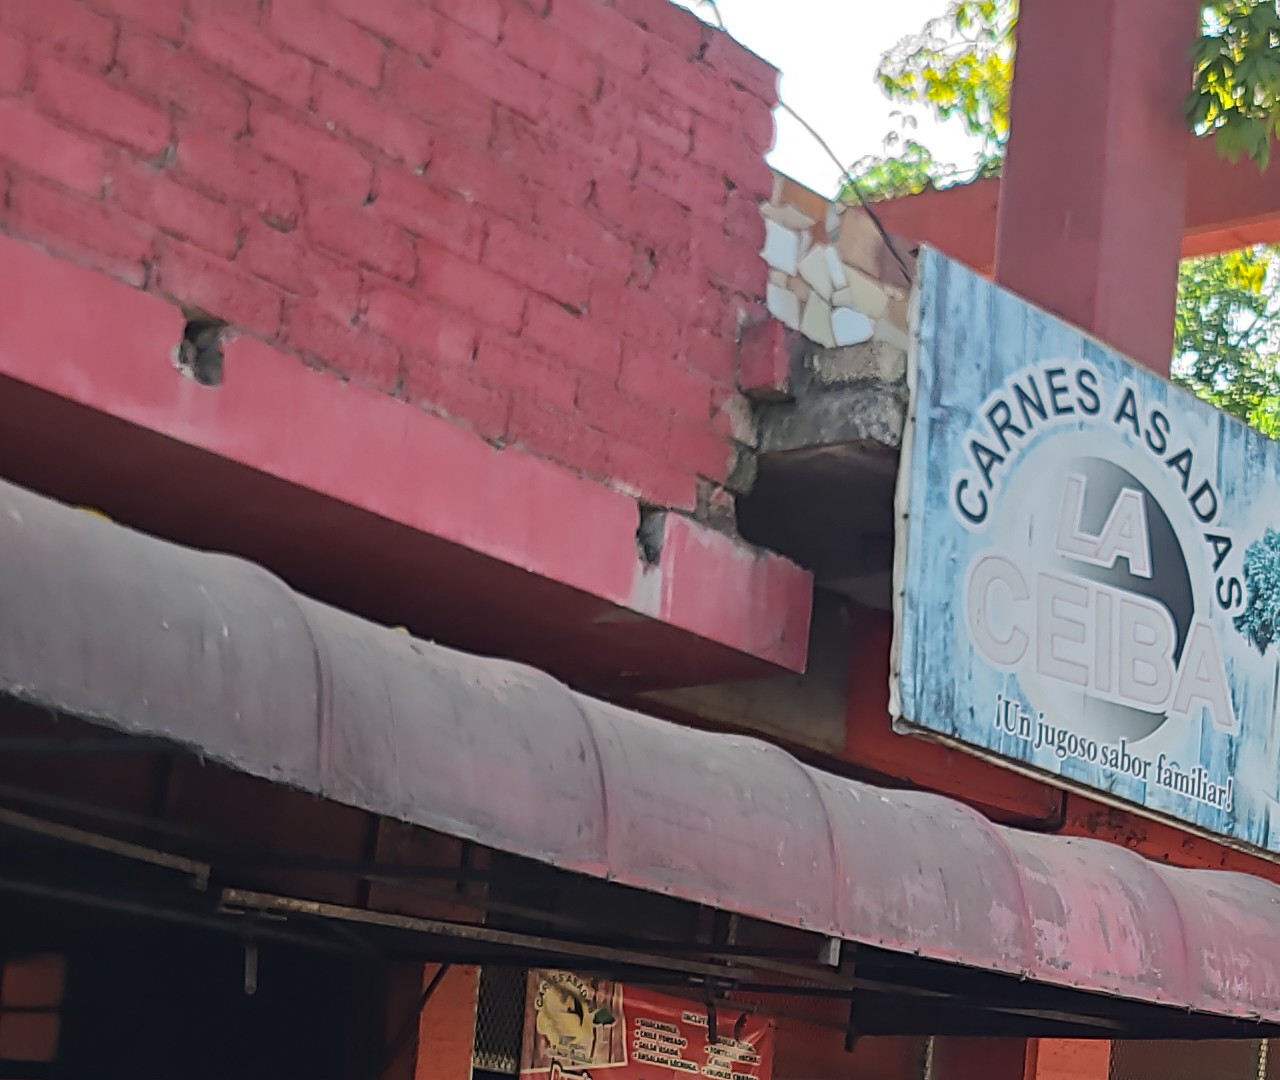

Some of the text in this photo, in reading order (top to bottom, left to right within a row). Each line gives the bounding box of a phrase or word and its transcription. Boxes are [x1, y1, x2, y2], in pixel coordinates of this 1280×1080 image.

[955, 367, 1243, 611] CARNES ASADAS
[1056, 477, 1151, 577] LA
[967, 555, 1238, 733] CEIBA
[995, 695, 1234, 811] ¡Un jugoso sabor familiar!
